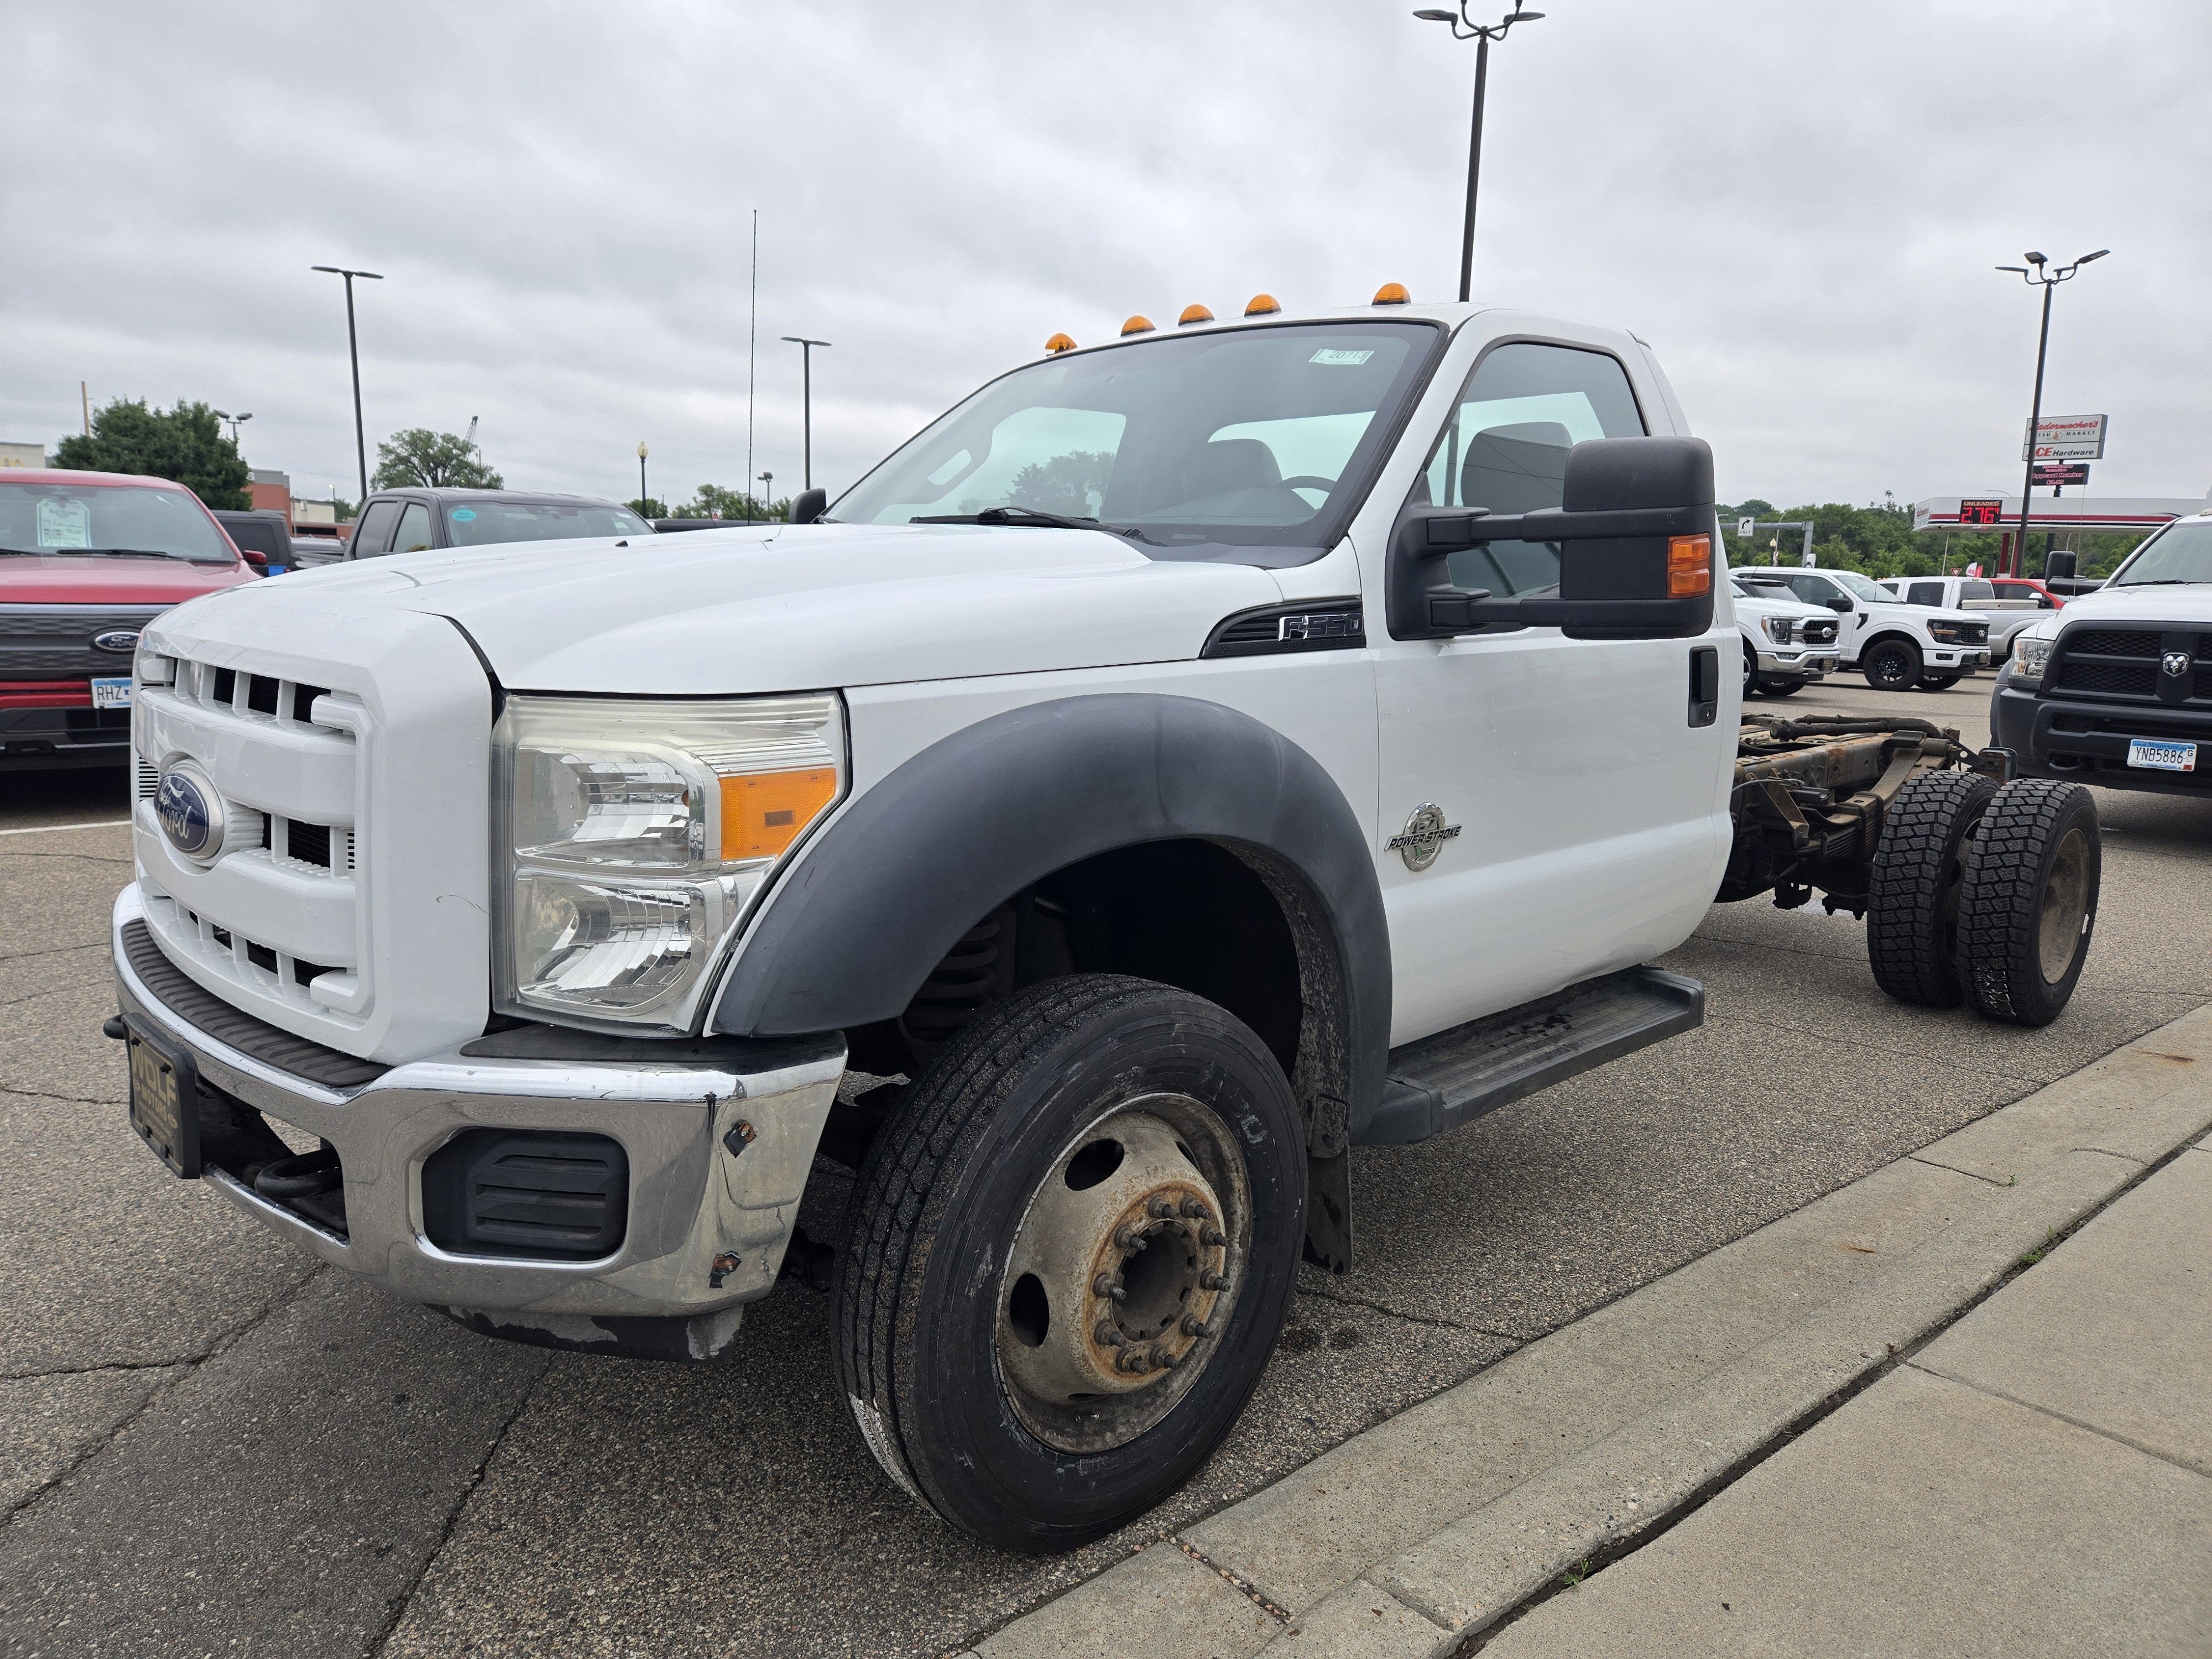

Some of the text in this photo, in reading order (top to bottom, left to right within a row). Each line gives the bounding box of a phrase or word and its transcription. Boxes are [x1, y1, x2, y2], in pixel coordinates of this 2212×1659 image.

[2029, 420, 2099, 431] adermacher's
[109, 636, 137, 646] Ford
[1282, 640, 1326, 649] SUPER
[2136, 747, 2184, 764] YNB5886
[132, 1045, 176, 1107] WOLF
[142, 1086, 170, 1121] MOTORS
